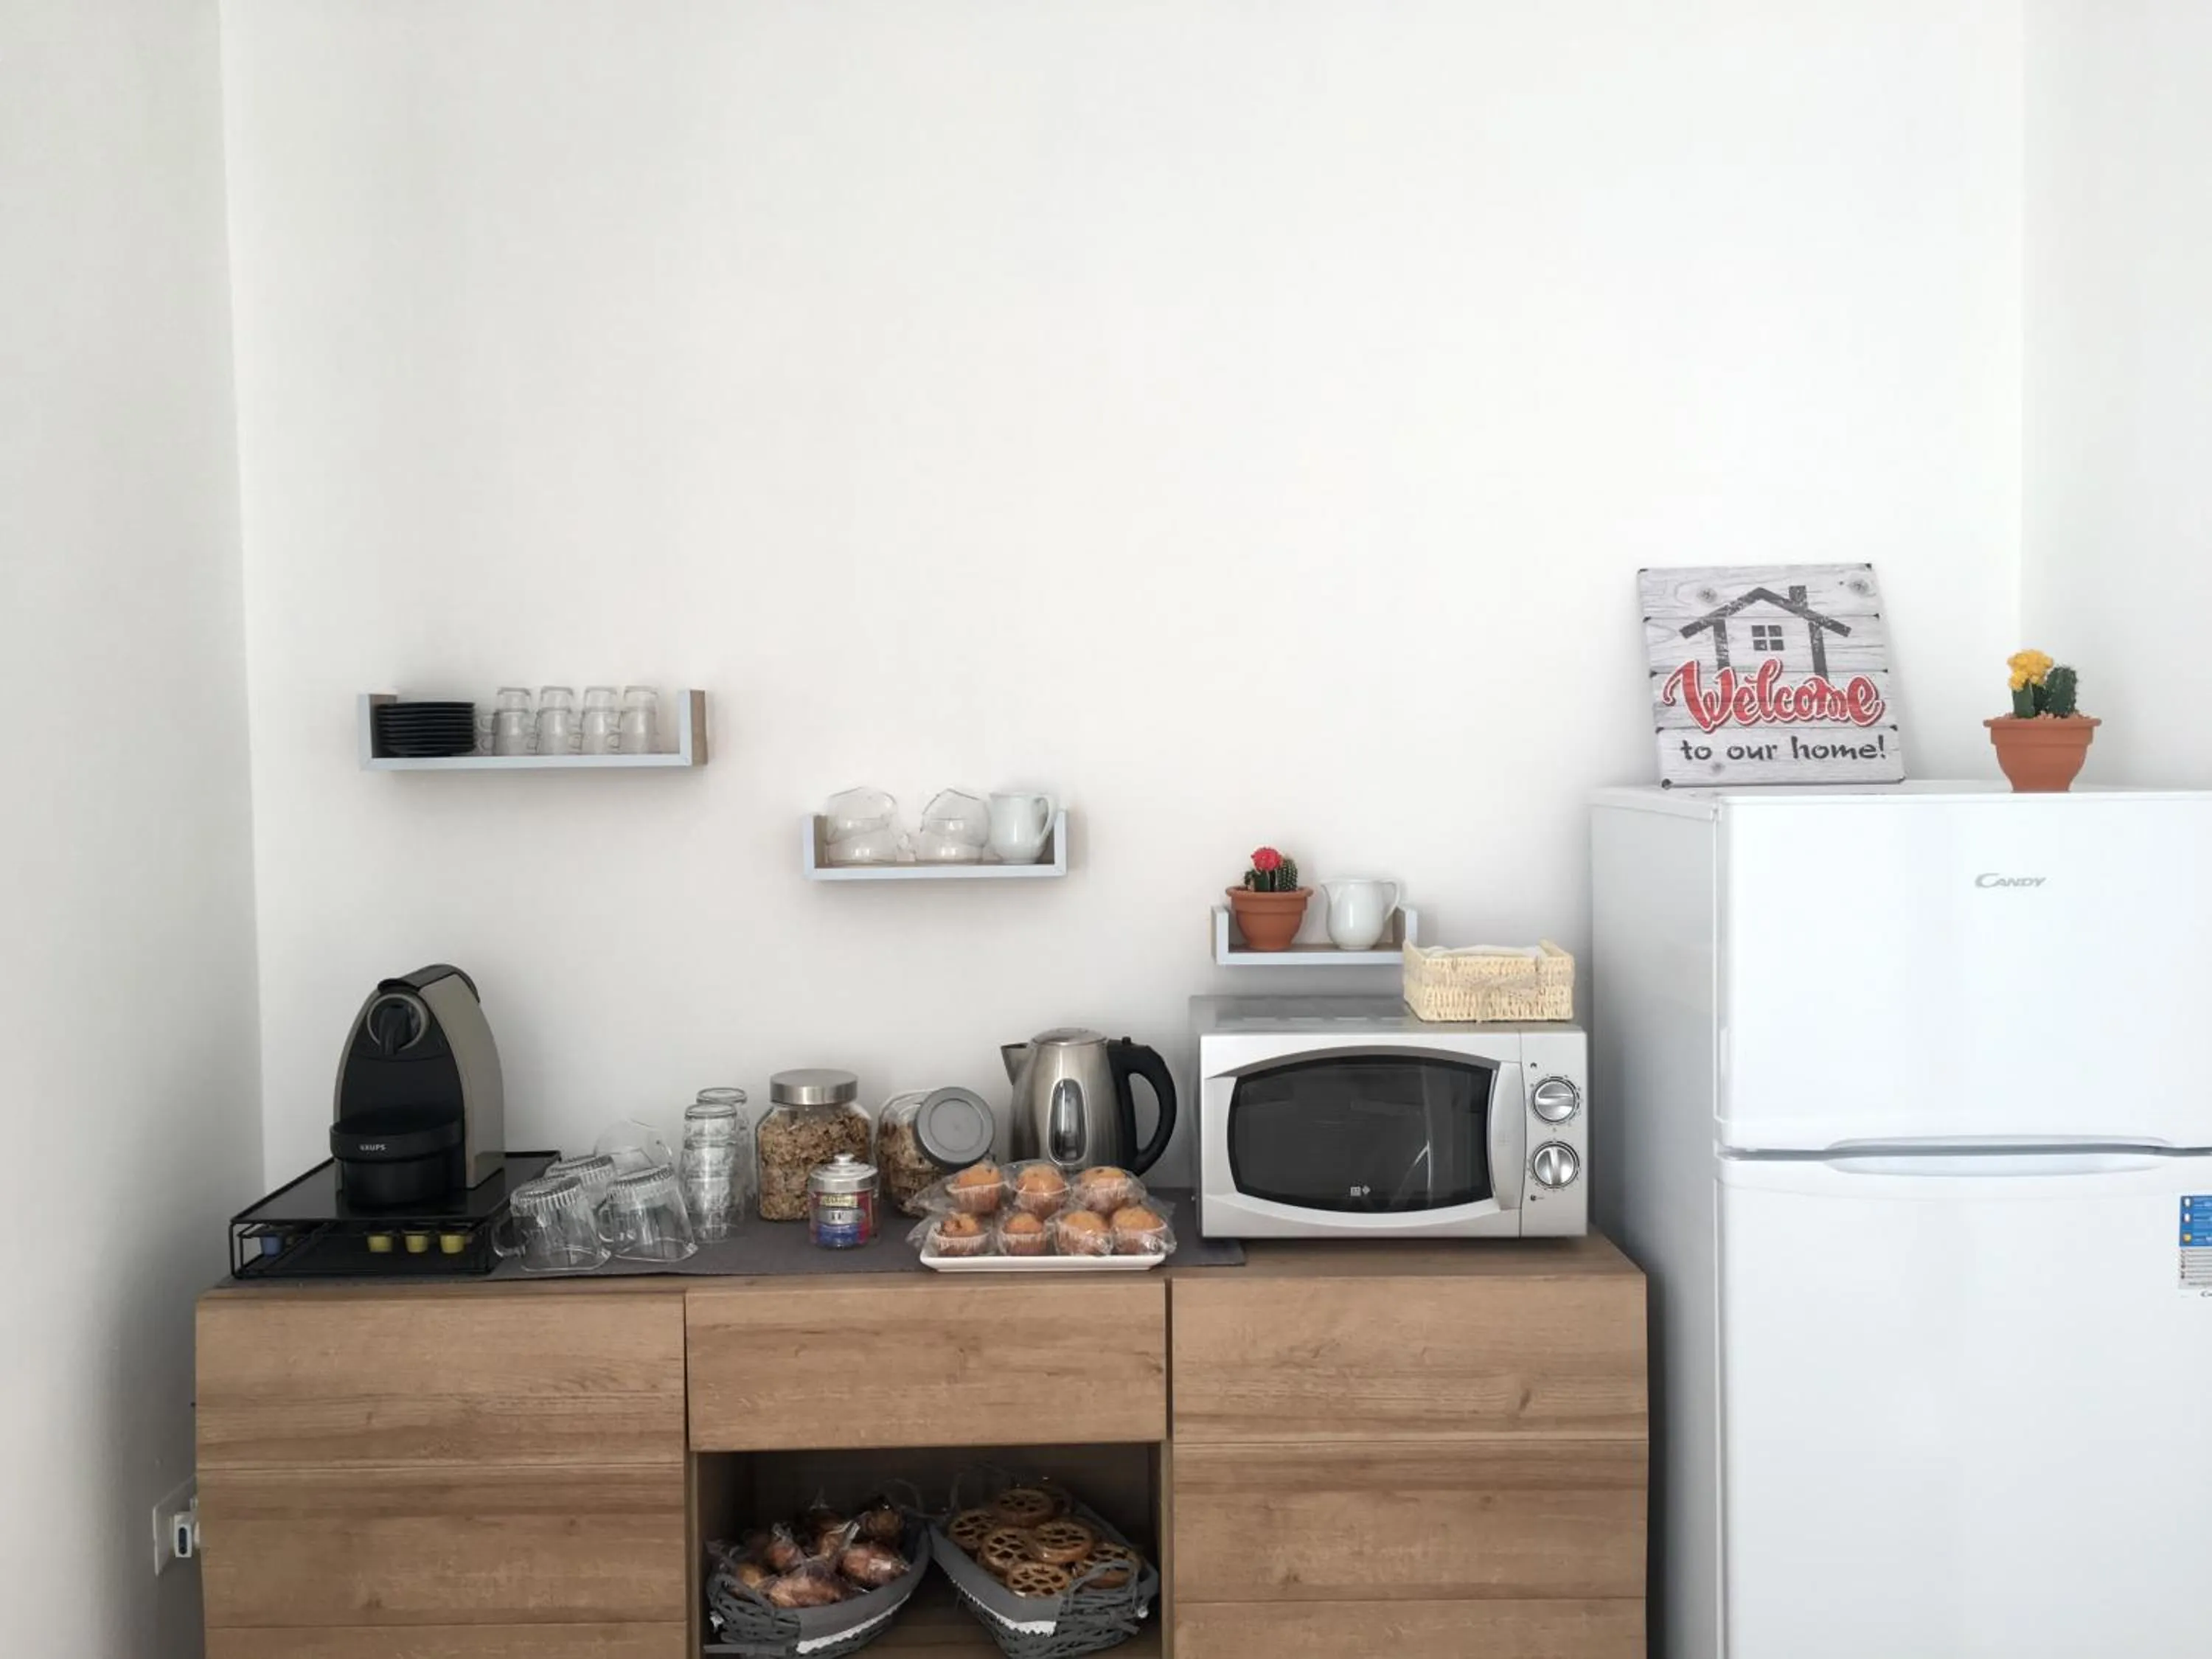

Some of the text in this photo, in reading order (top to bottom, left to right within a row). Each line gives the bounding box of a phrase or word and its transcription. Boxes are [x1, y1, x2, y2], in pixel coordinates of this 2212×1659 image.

[1663, 658, 1885, 733] Welcome
[1680, 735, 1886, 761] to our home!
